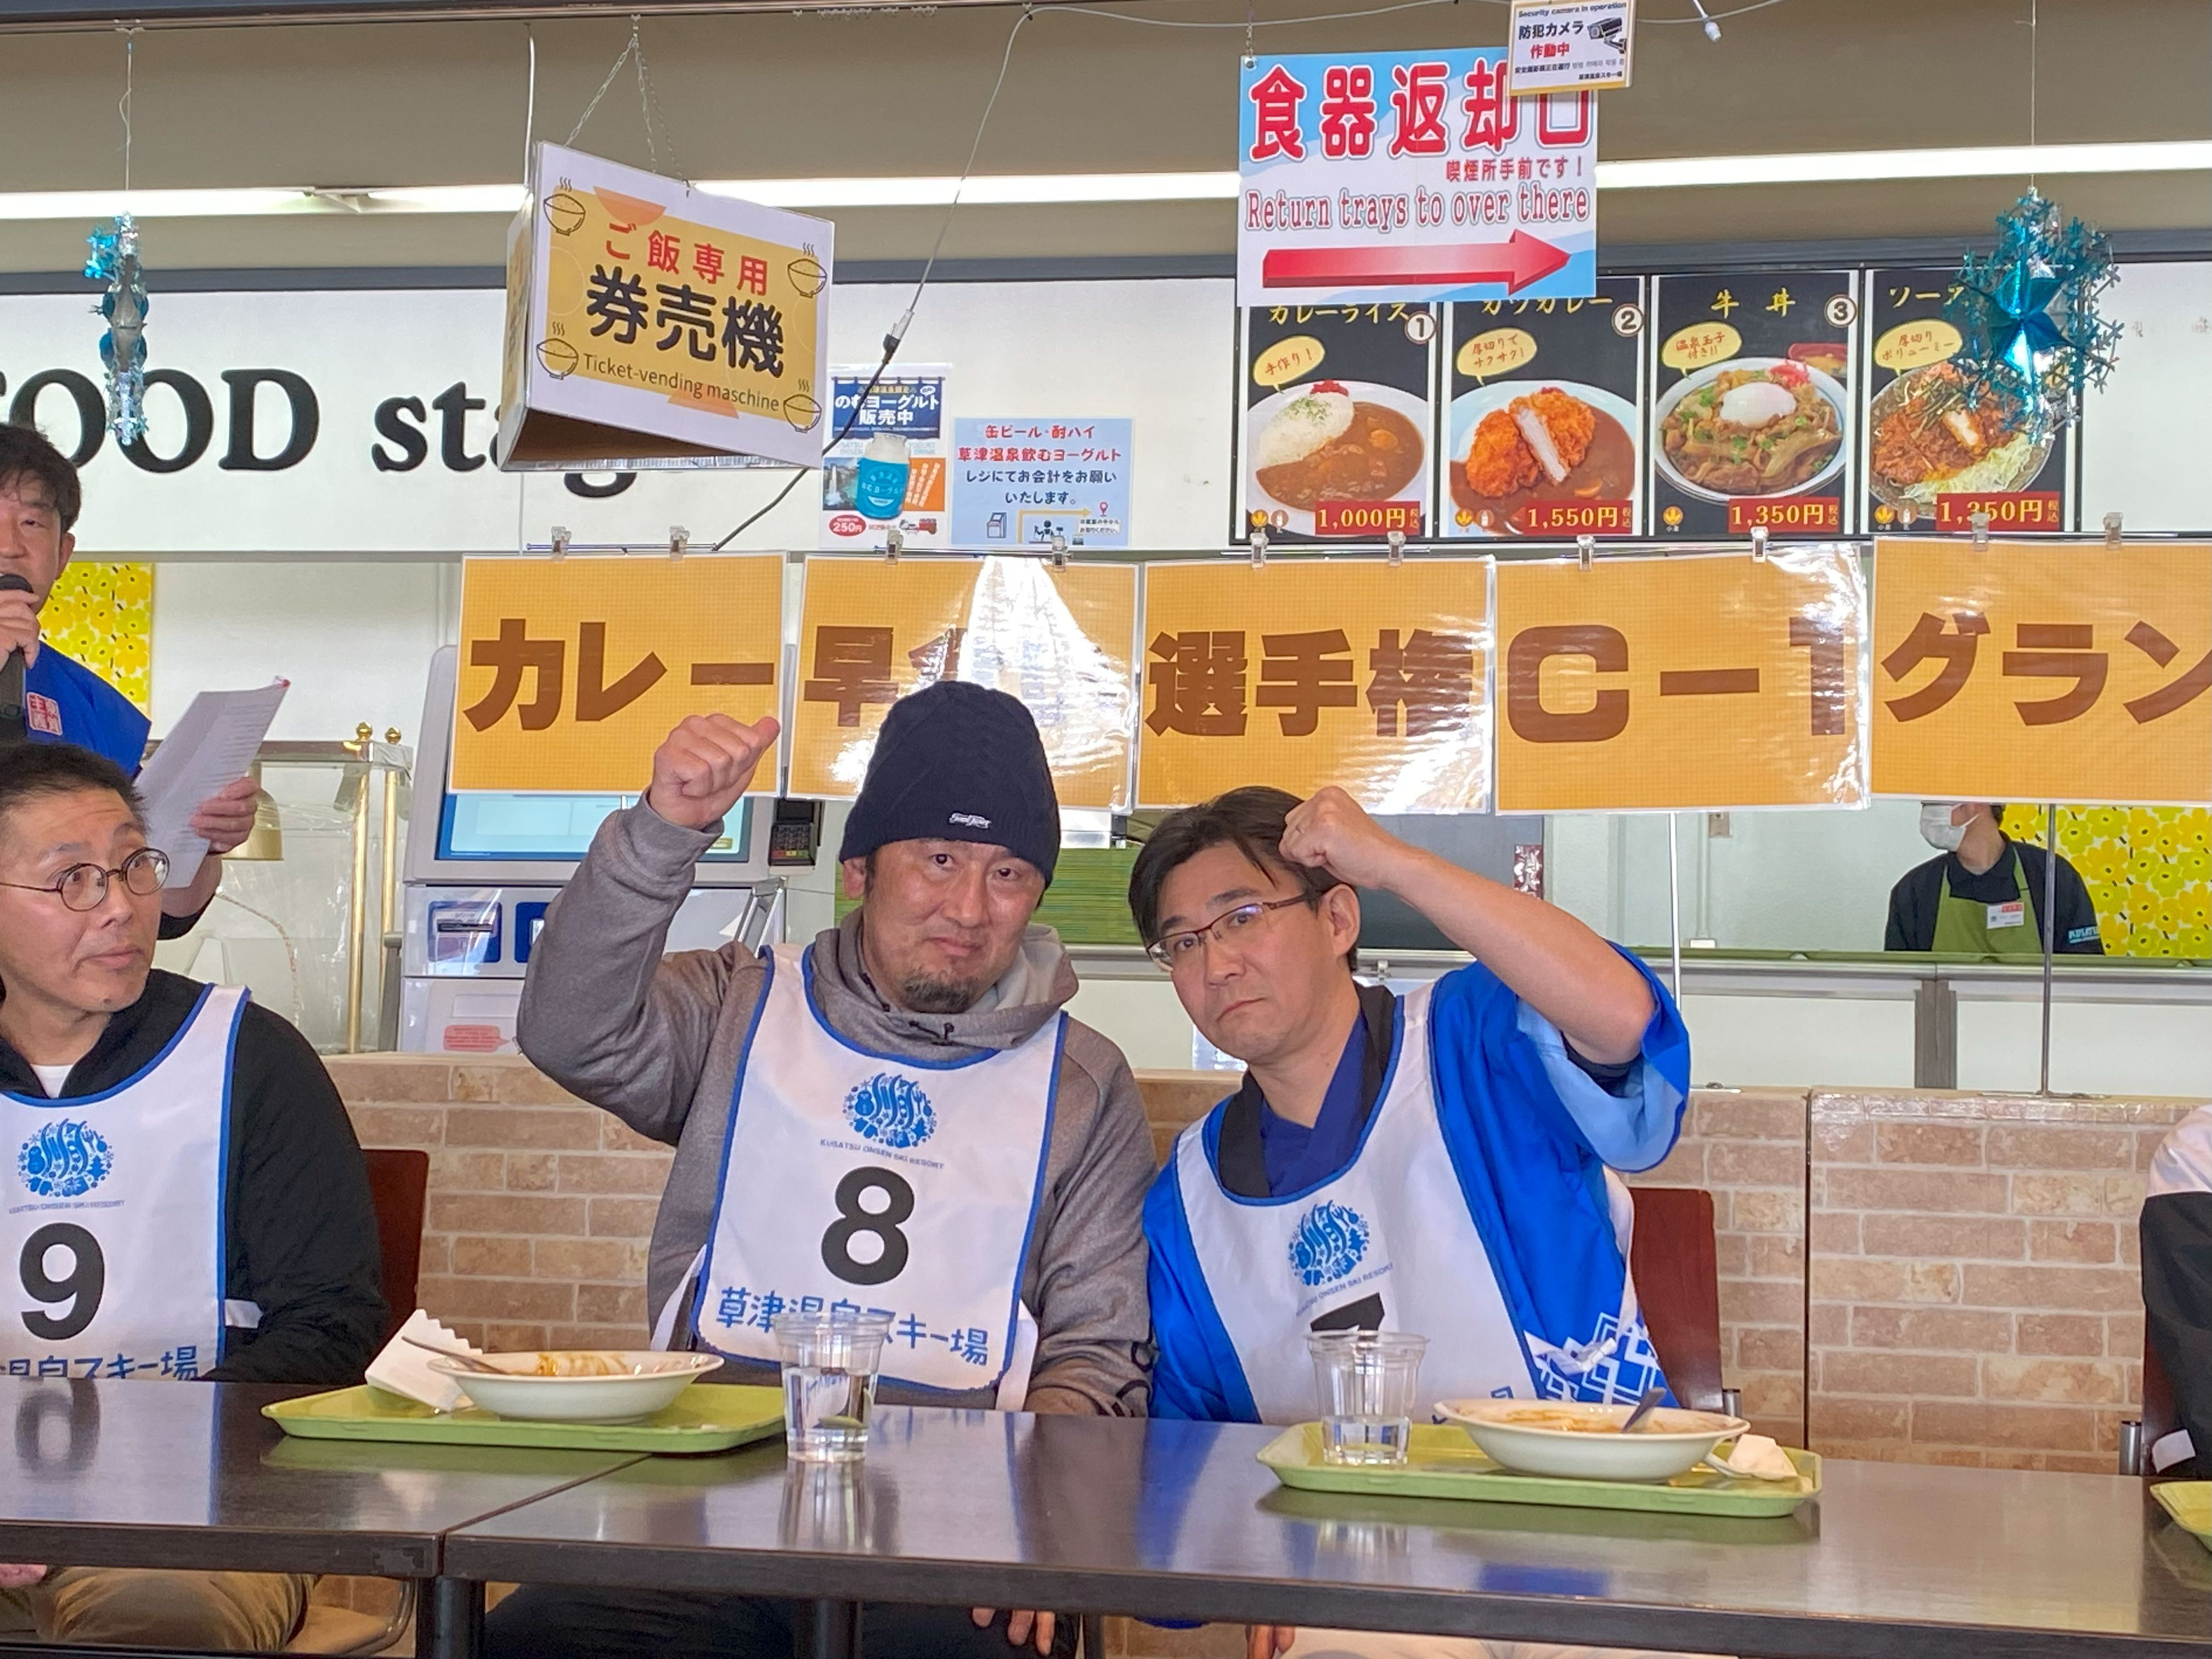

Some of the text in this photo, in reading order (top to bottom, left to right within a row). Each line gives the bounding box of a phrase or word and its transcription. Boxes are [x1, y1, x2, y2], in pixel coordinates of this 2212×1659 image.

[1590, 2, 1627, 12] operation
[1519, 20, 1584, 40] 防犯カメラ
[1530, 42, 1570, 59] 作動中
[1249, 59, 1590, 160] 食器返却口
[1248, 182, 1589, 231] Return trays to over there
[605, 223, 768, 296] ご飯専用
[585, 264, 783, 377] 券売機
[1269, 303, 1409, 325] カレーライス
[584, 353, 780, 411] Ticket-vending maschine
[859, 409, 913, 425] 販売中
[957, 447, 1121, 461] 草津温泉飲むヨーグルト
[966, 470, 1117, 483] レジにてお会計をお願い
[1006, 492, 1076, 505] いたします。
[1318, 508, 1406, 529] 1,000円
[1528, 507, 1617, 529] 1,550円
[1731, 504, 1824, 527] 1,350円
[833, 522, 862, 532] 250円
[464, 619, 774, 731] カレー
[1881, 612, 2212, 726] グラン
[821, 1166, 915, 1286] 8
[19, 1222, 105, 1340] 9
[1348, 1277, 1362, 1288] SKI
